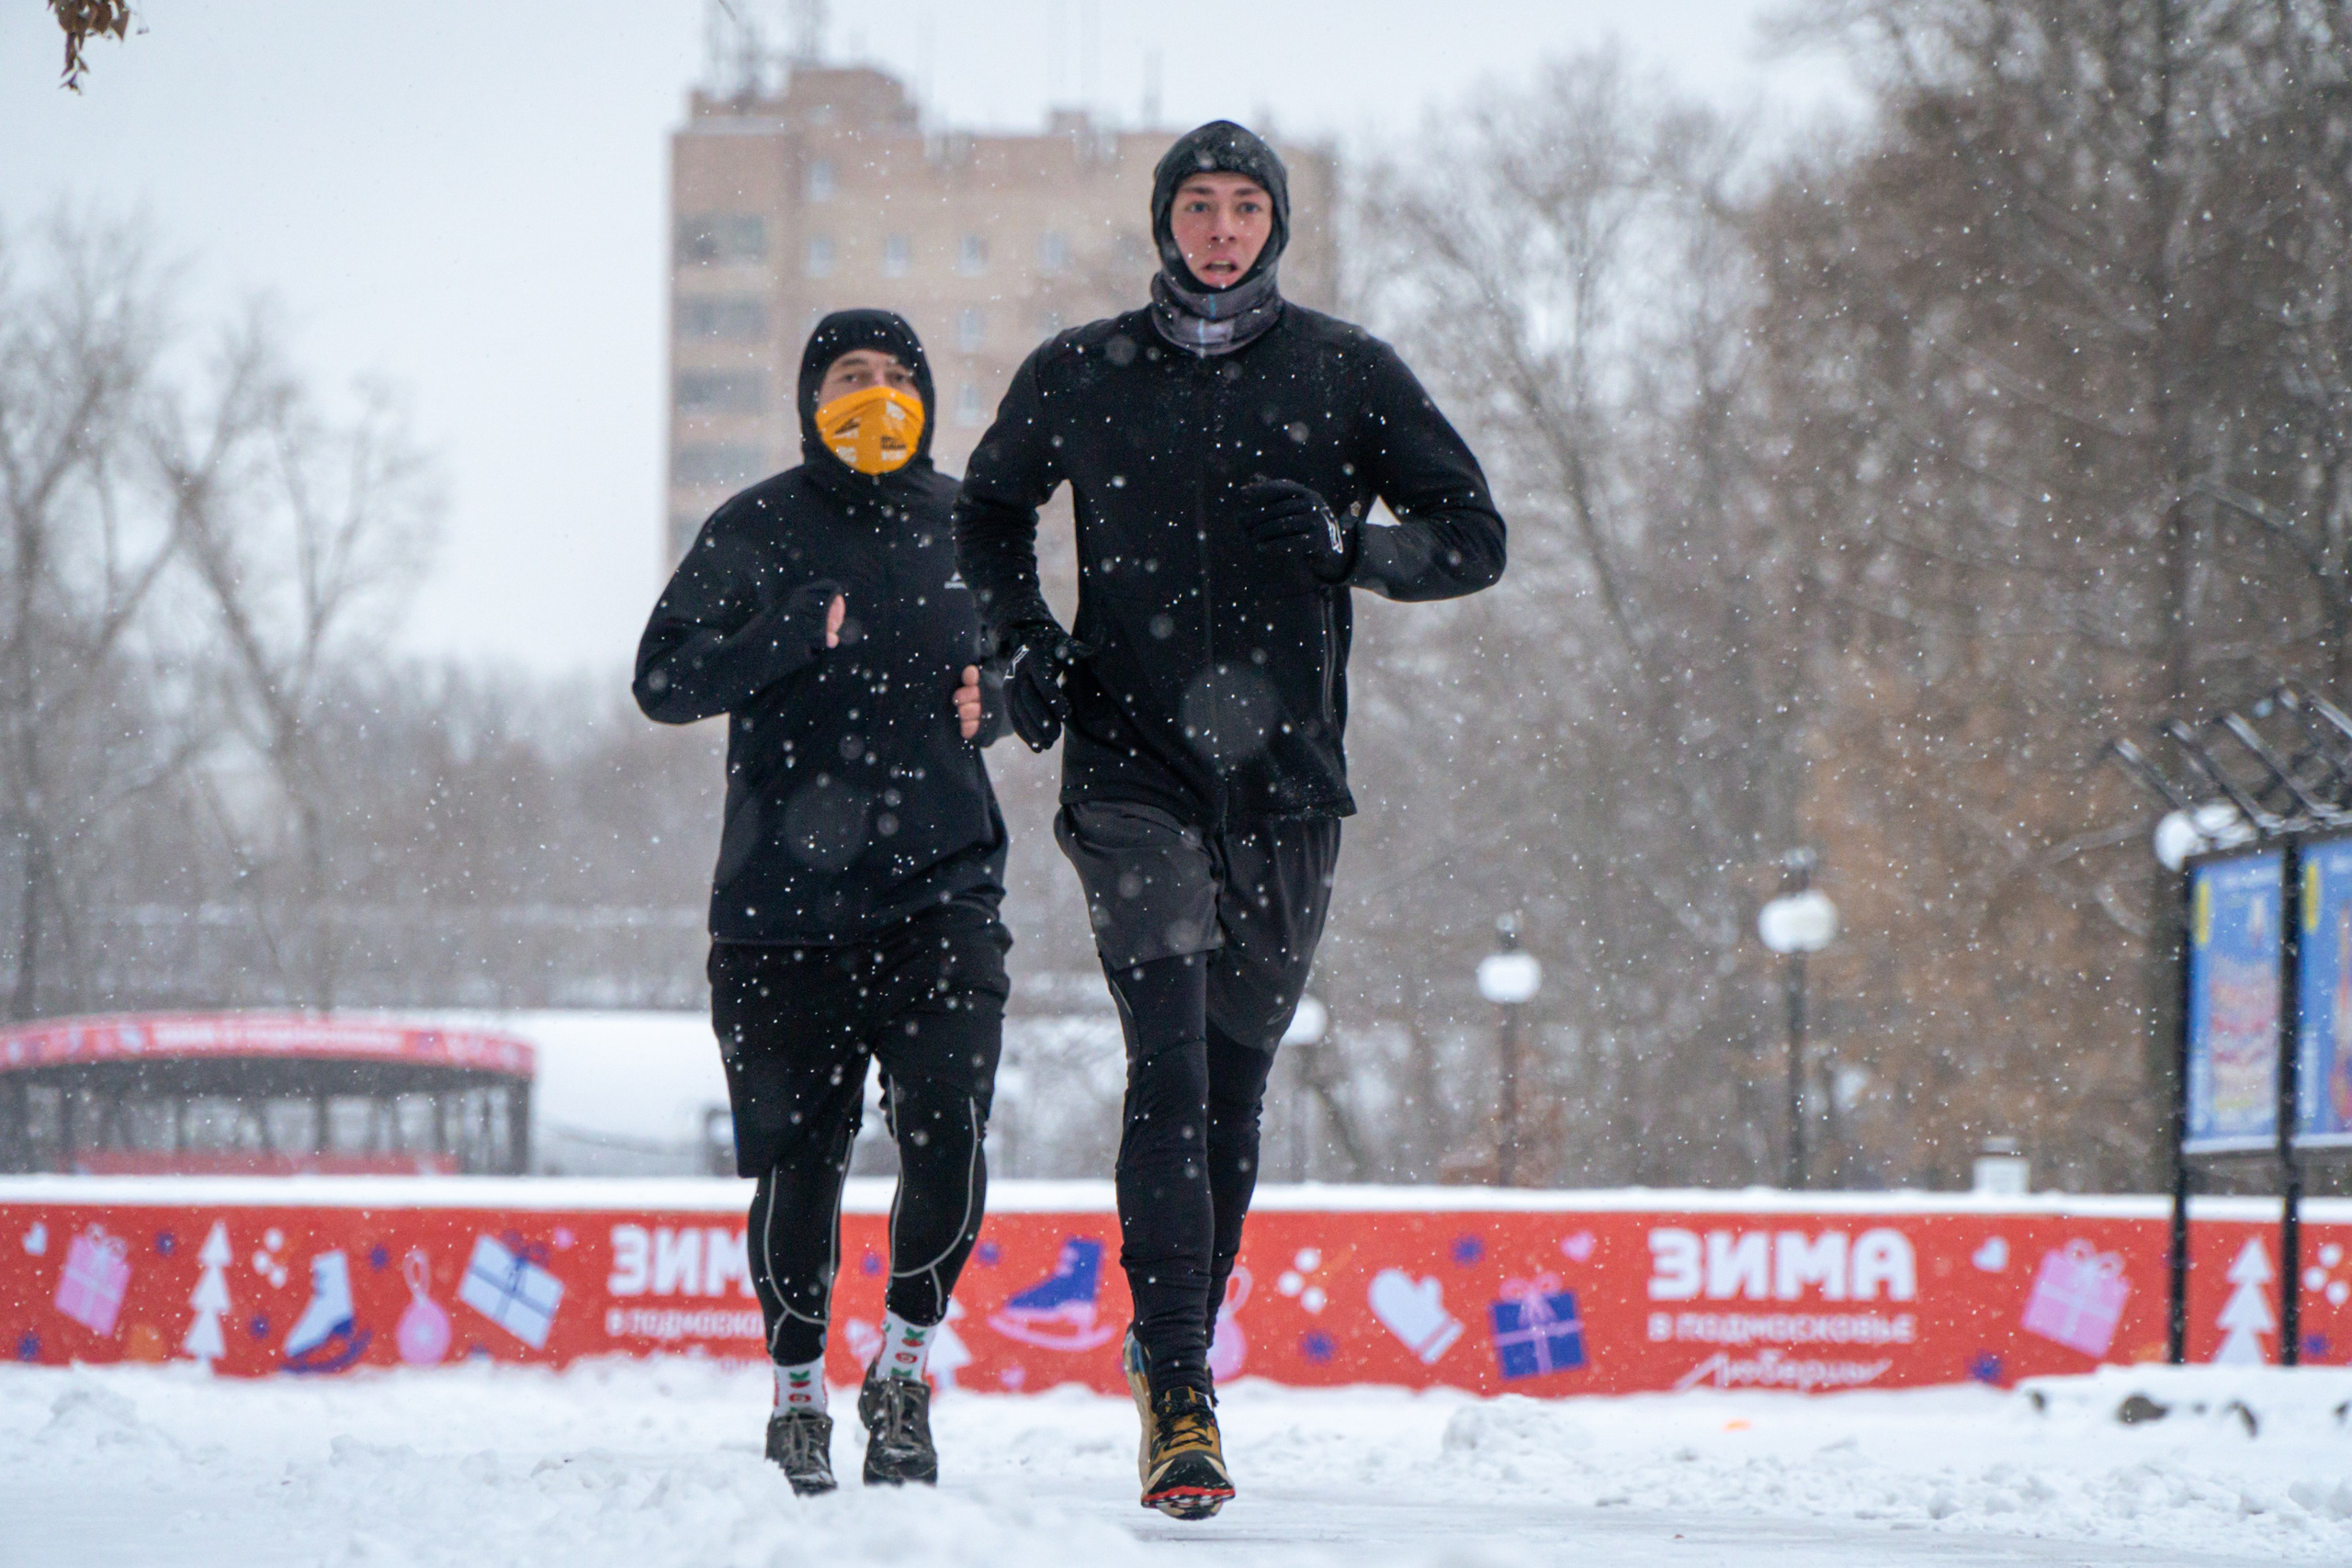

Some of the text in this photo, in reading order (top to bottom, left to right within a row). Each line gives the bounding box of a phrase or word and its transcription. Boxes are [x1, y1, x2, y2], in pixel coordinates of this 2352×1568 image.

[607, 1224, 757, 1297] ЗИМ
[1648, 1228, 1917, 1301] ЗИМА
[605, 1307, 765, 1341] В ПОДМОСКО
[1647, 1313, 1916, 1344] В ПОДМОСКОВЬЕ
